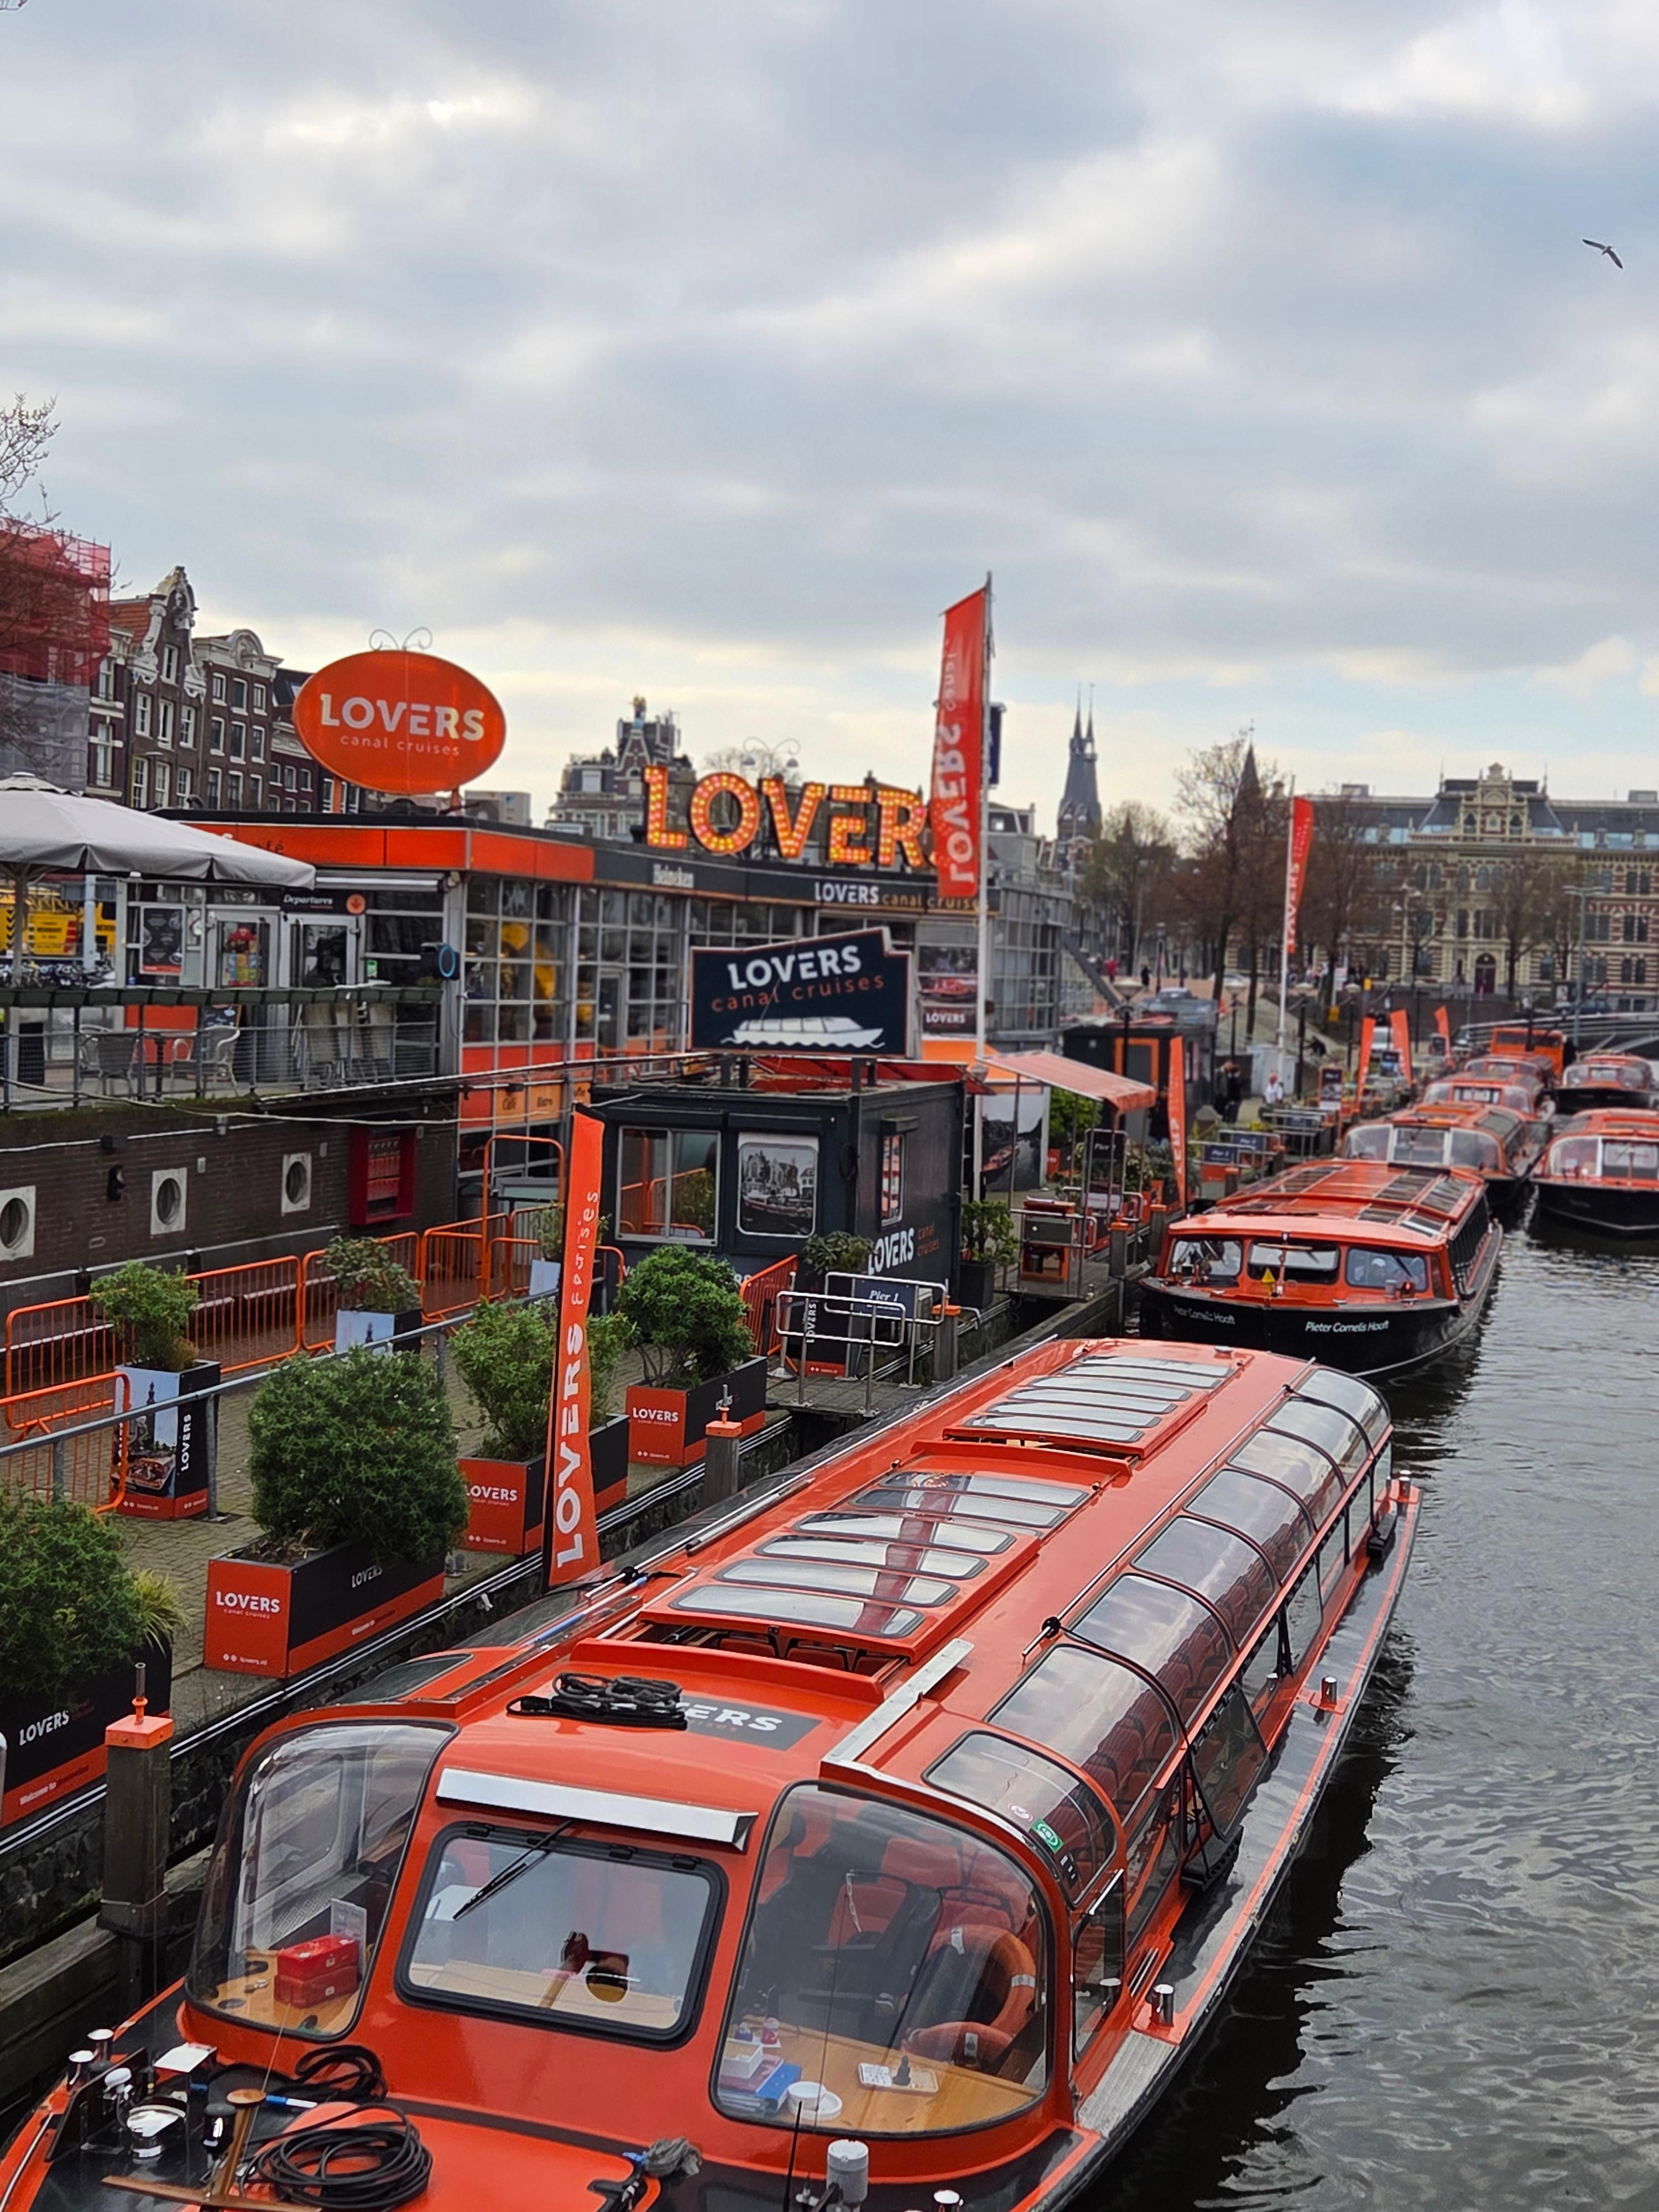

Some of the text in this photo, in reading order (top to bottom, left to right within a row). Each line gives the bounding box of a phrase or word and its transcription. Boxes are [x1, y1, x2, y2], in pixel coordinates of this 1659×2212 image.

[320, 692, 485, 742] LOVERS
[340, 734, 460, 757] canal cruises
[644, 765, 940, 868] LOVER
[815, 883, 879, 904] LOVERS
[881, 893, 922, 907] canal
[727, 945, 862, 990] LOVERS
[711, 974, 884, 1013] canal cruises
[925, 1013, 967, 1023] LOVERS
[868, 1227, 915, 1276] LOVERS
[868, 1289, 891, 1301] Pier
[1305, 1321, 1332, 1332] Pieter
[632, 1406, 679, 1422] LOVERS
[181, 1413, 192, 1472] LOVERS
[556, 1323, 584, 1569] LOVERS
[216, 1590, 281, 1613] LOVERS
[19, 1710, 70, 1746] LOVERS
[676, 1702, 783, 1731] ERS
